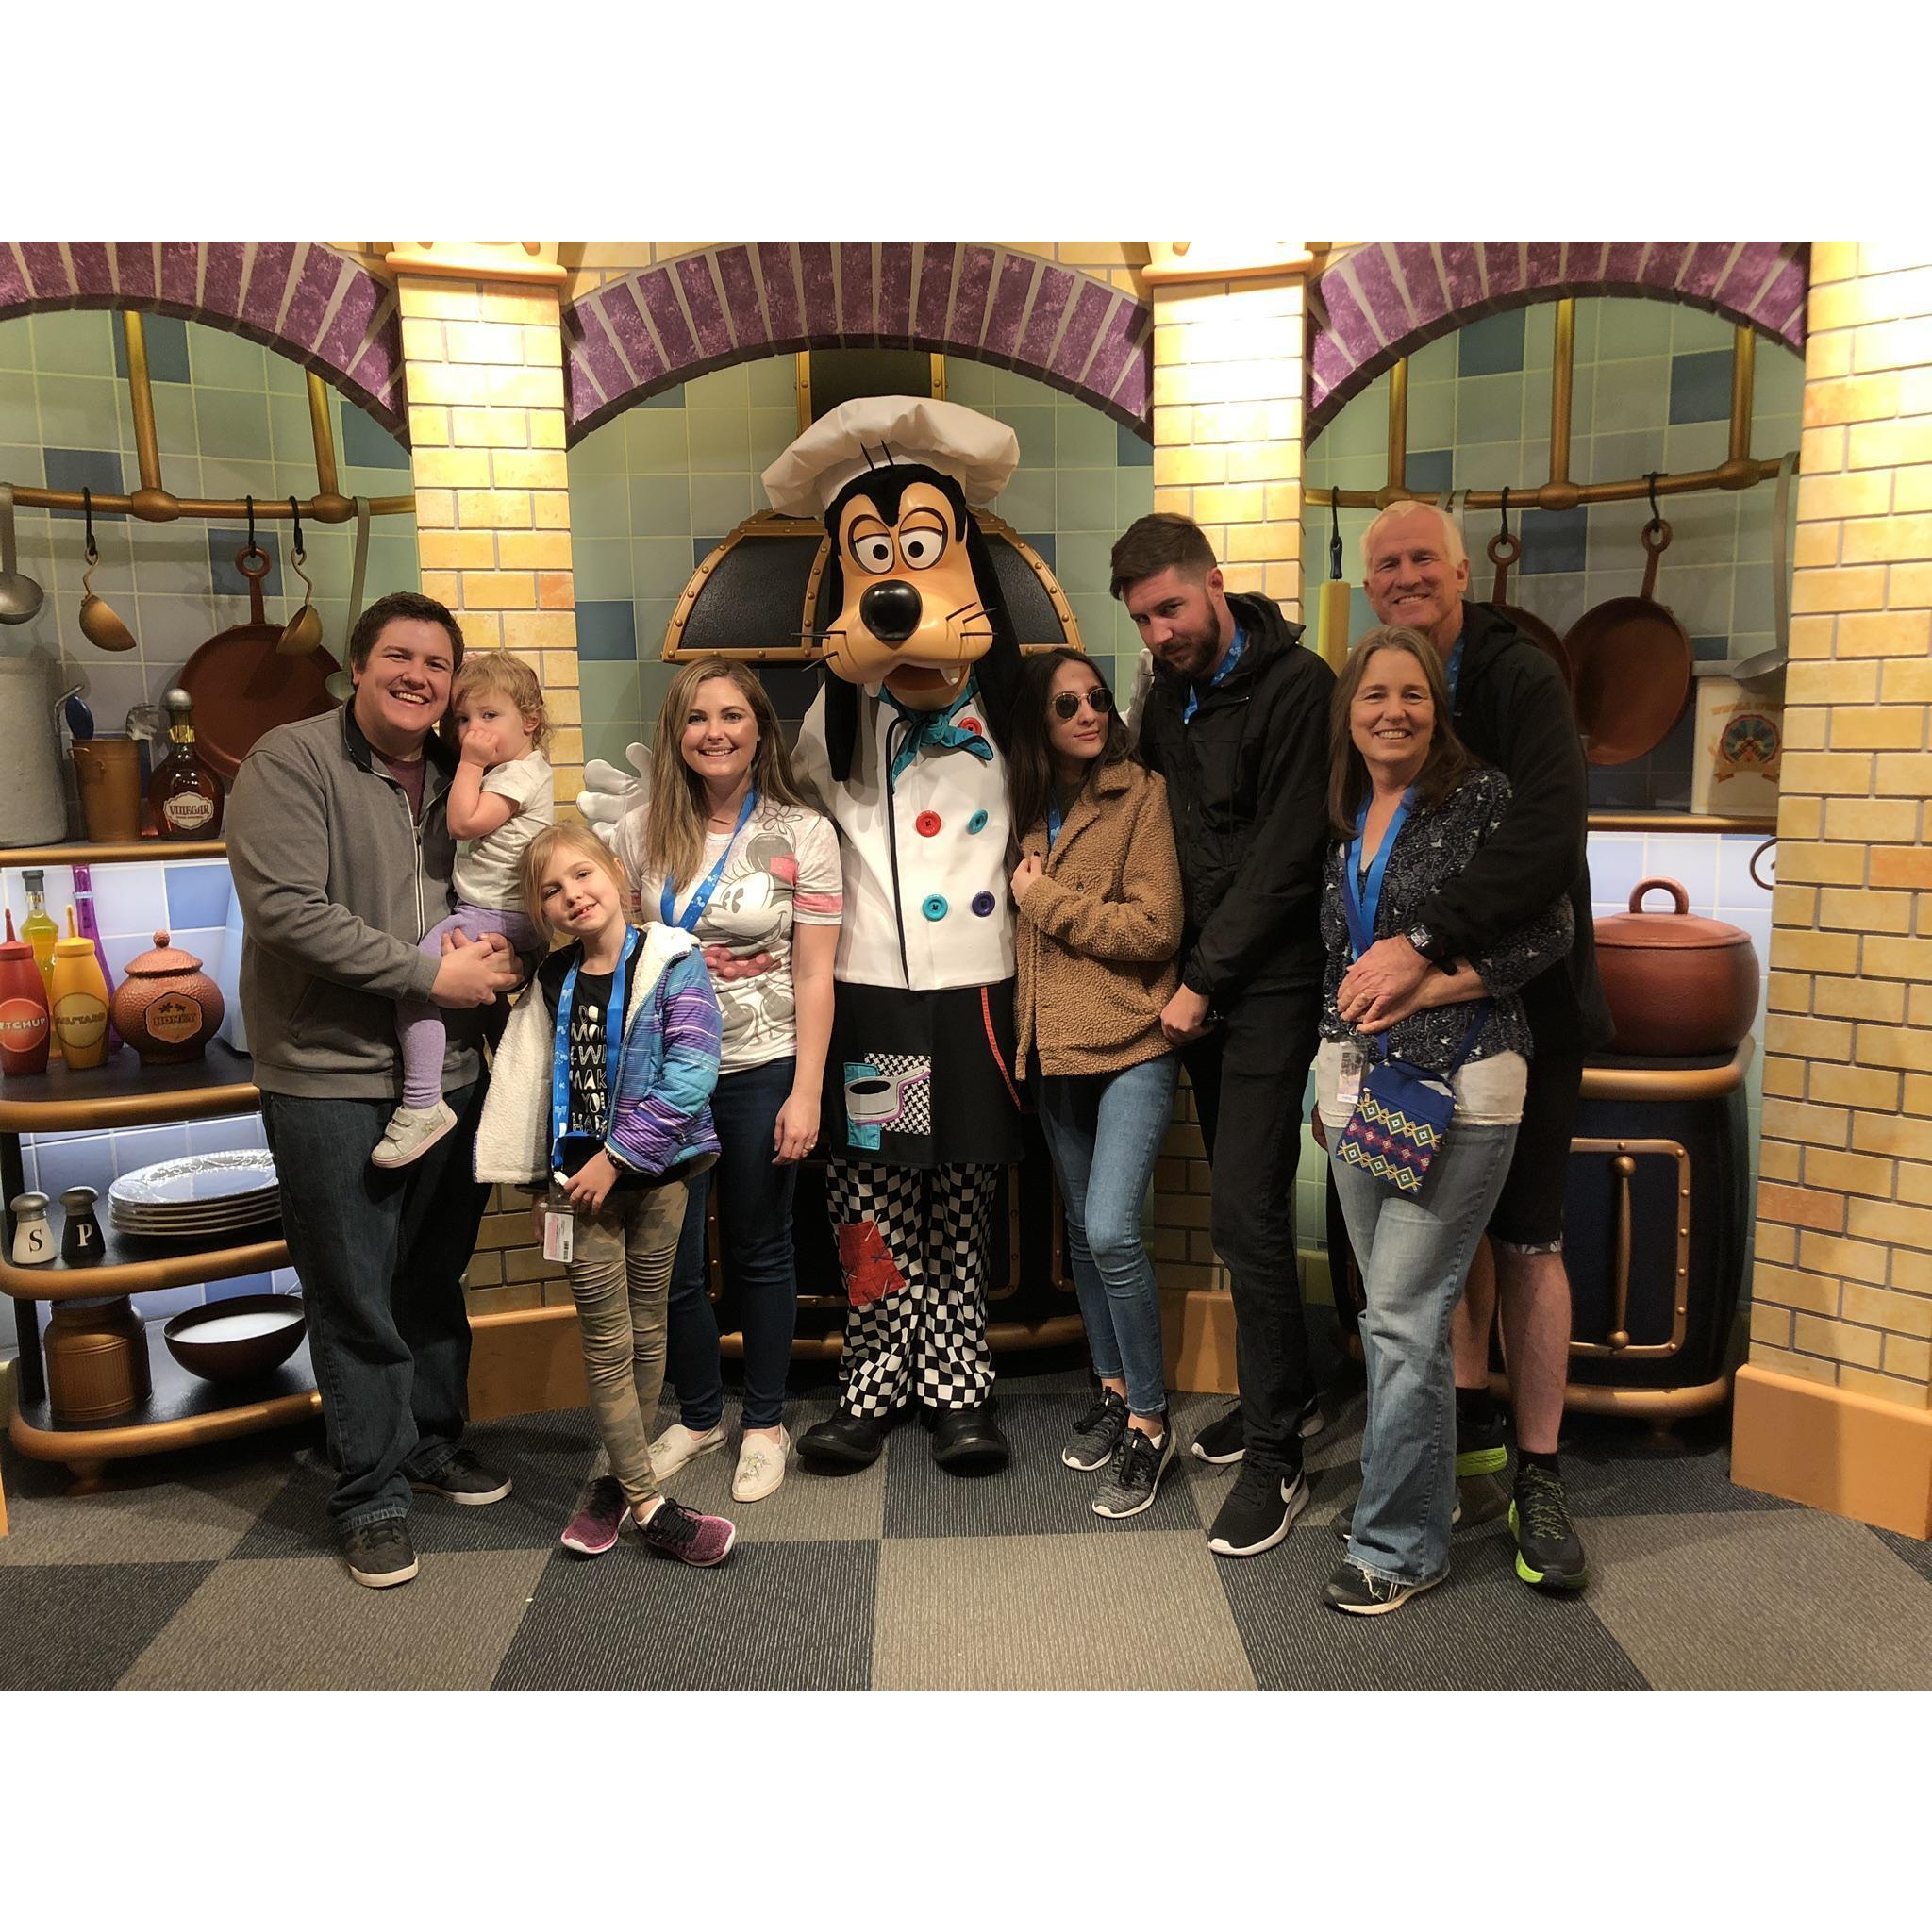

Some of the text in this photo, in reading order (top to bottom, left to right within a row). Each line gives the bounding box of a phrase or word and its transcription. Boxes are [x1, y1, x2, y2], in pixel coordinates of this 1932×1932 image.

[170, 805, 209, 815] VINEGAR
[151, 1012, 197, 1026] HONEY
[578, 1005, 599, 1024] DO
[28, 1228, 43, 1253] S
[76, 1224, 93, 1247] P
